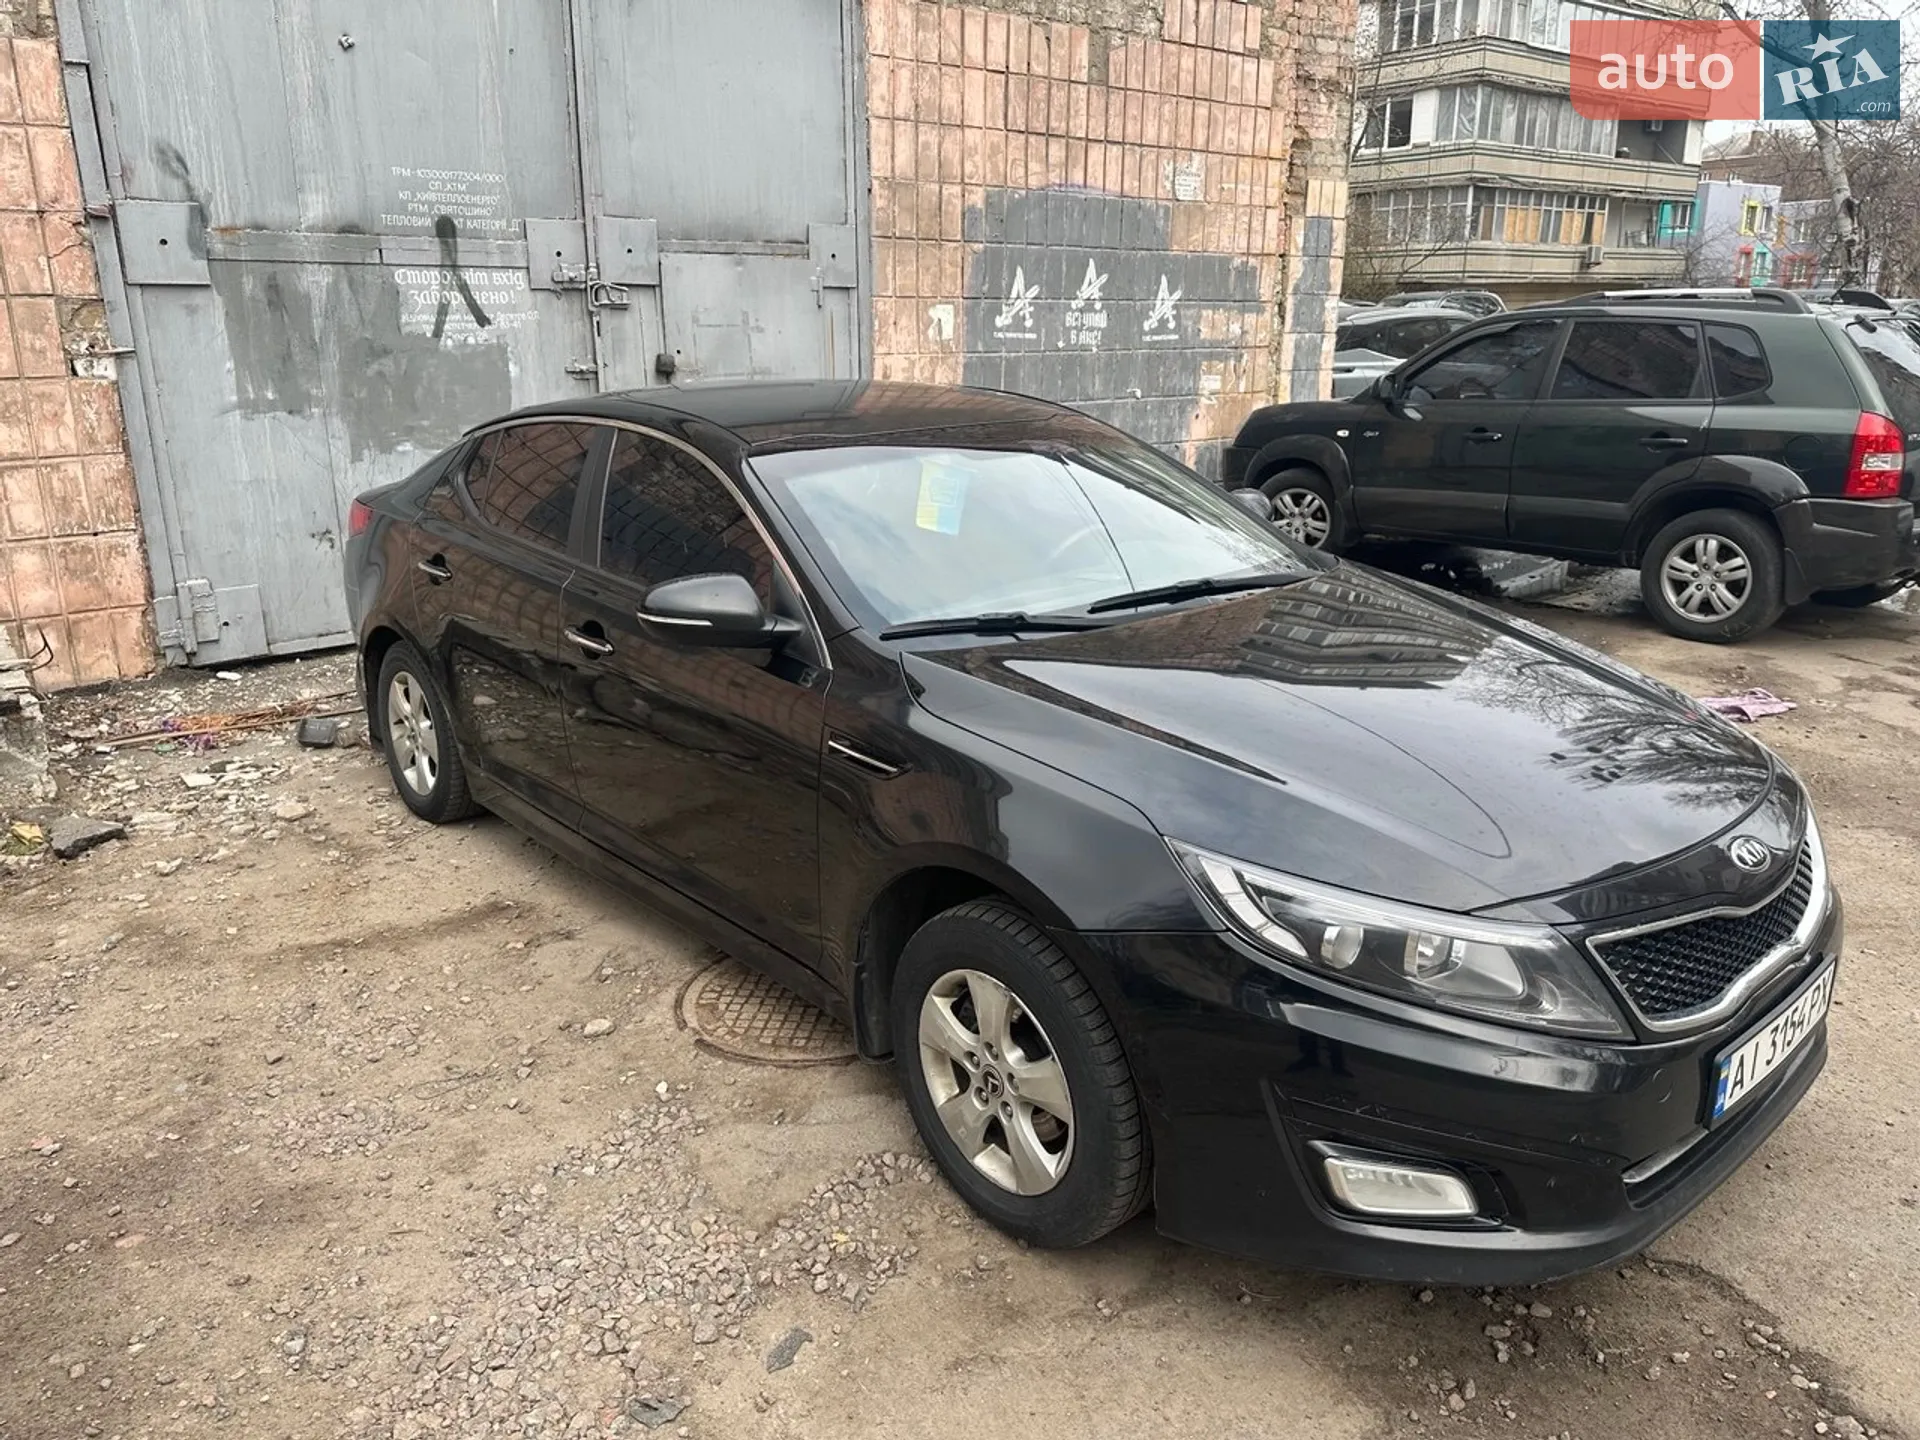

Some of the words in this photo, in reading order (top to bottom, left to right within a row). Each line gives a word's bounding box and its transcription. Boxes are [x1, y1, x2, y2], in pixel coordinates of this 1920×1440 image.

[428, 180, 443, 191] СП
[398, 190, 412, 201] КП
[408, 202, 429, 213] РТМ
[381, 213, 432, 228] ТЕПЛОВИЙ
[394, 268, 489, 290] Сторонім
[1729, 1041, 1759, 1099] AI
